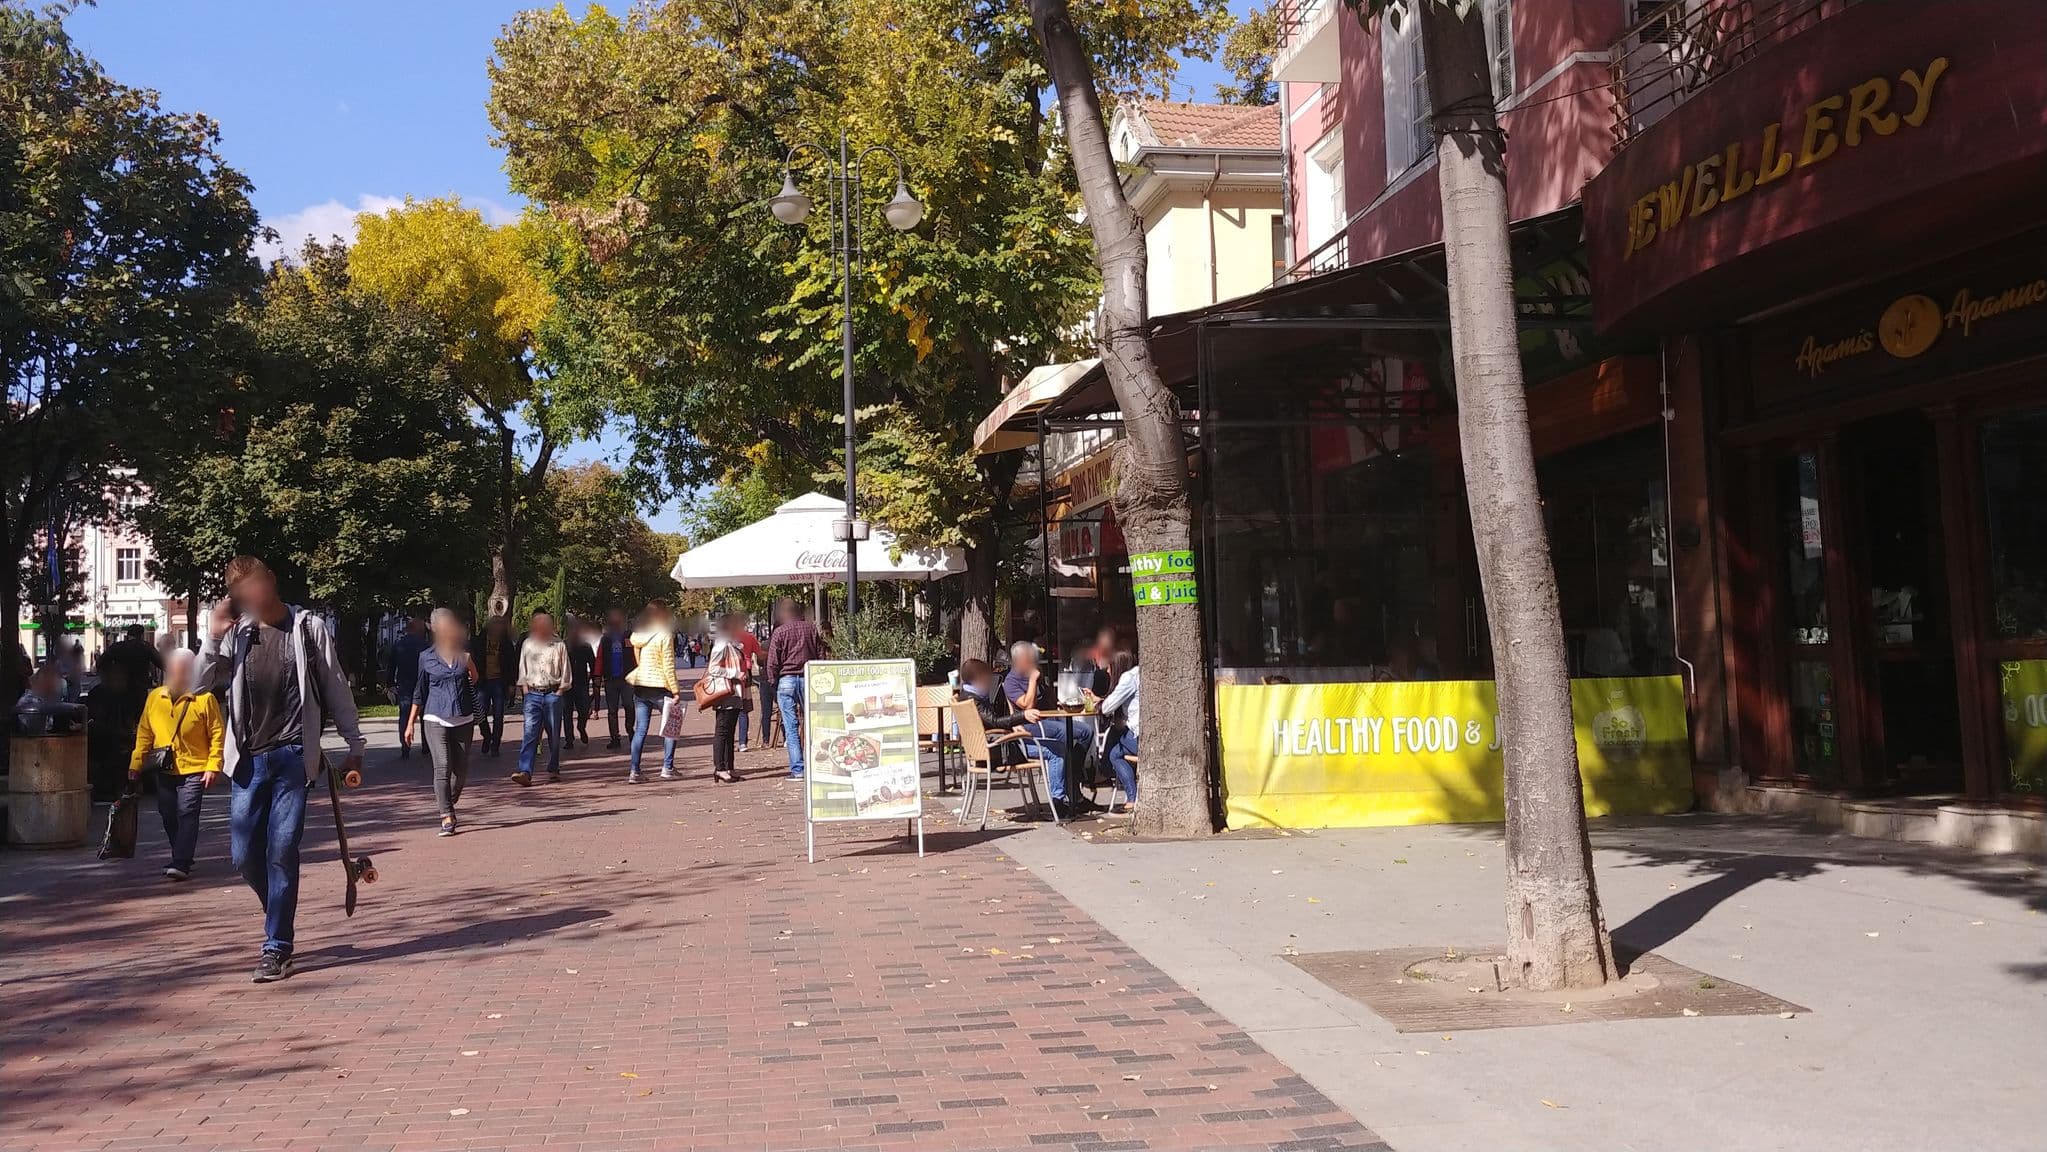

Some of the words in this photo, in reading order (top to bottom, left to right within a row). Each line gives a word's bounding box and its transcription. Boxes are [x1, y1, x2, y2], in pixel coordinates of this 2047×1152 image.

[1623, 57, 1950, 262] JEWELLERY
[1150, 586, 1162, 600] &
[1272, 717, 1384, 756] HEALTHY
[1392, 716, 1459, 753] FOOD
[1464, 720, 1481, 745] &
[1602, 726, 1641, 739] Fresh
